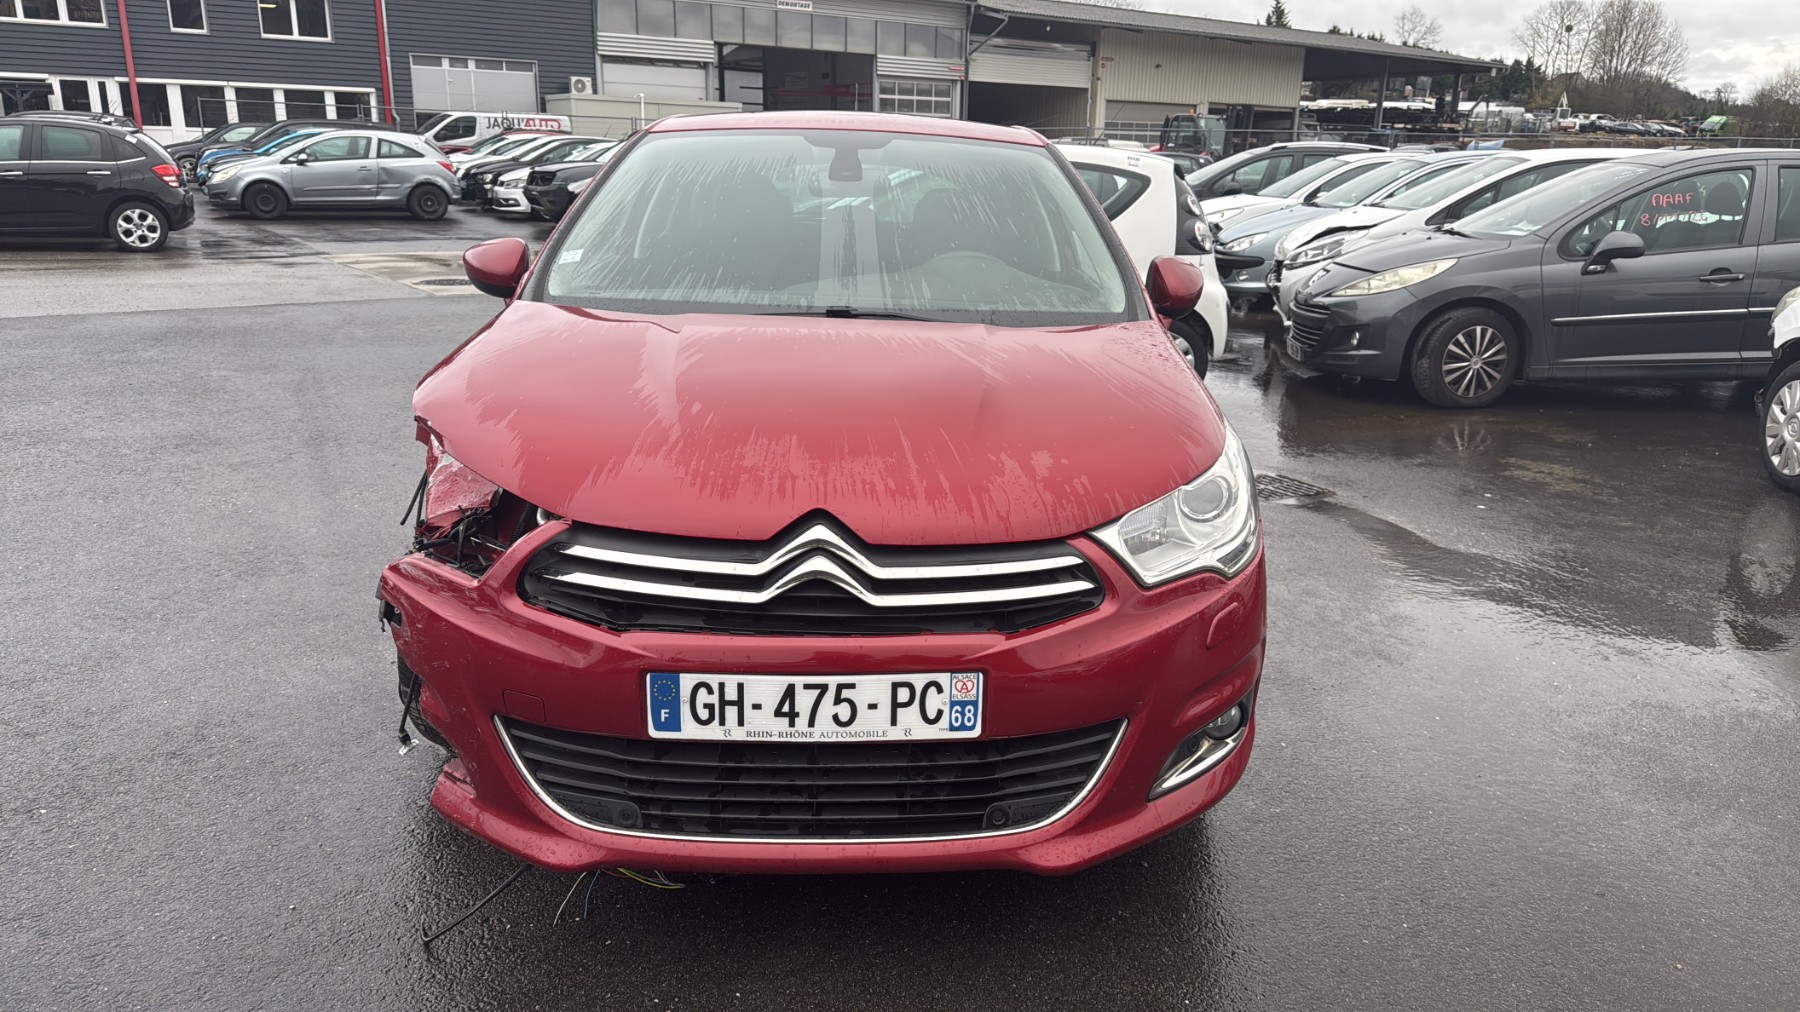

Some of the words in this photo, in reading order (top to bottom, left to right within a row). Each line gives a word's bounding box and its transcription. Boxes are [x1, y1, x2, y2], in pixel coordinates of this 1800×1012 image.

[661, 709, 669, 722] F
[951, 705, 975, 727] 68
[745, 729, 815, 739] RHIN-RHÔNE
[819, 730, 888, 739] AUTOMOBILE
